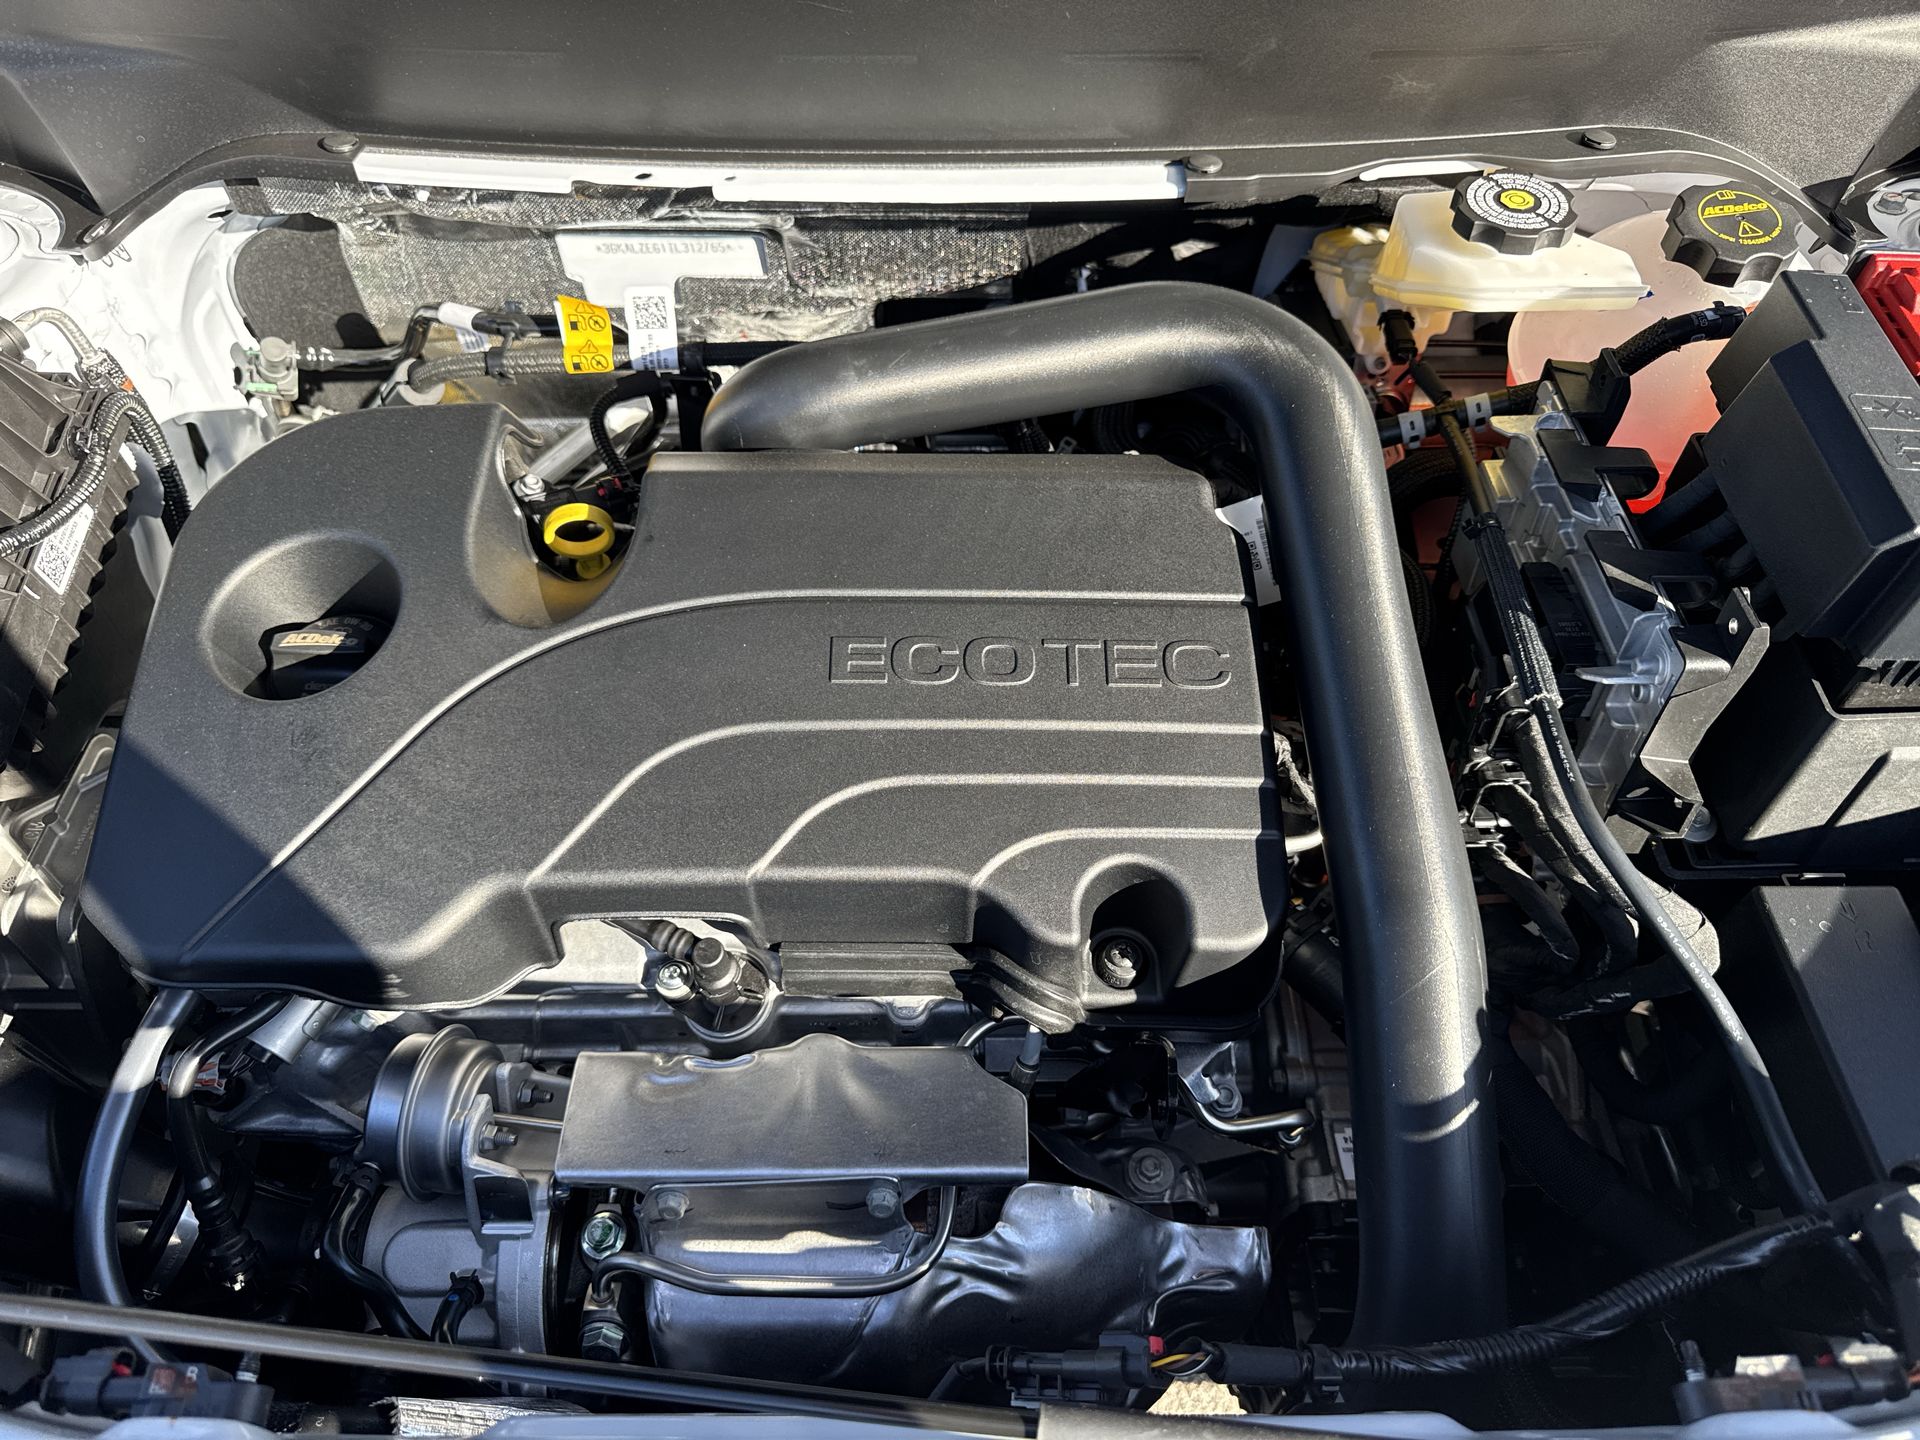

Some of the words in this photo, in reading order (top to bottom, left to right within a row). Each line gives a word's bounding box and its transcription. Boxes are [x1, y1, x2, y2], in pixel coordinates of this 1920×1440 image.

[1704, 202, 1768, 216] ACDelco
[280, 632, 359, 646] ACDelco
[829, 635, 1232, 690] ECOTEC
